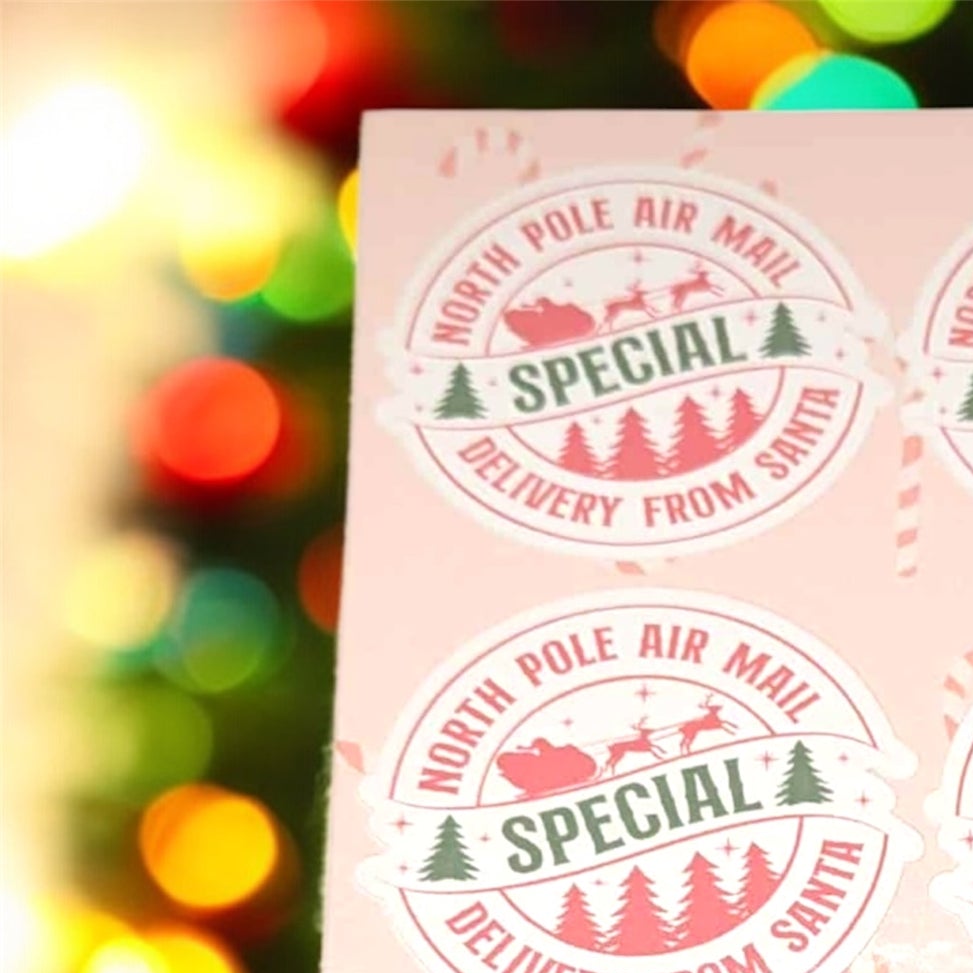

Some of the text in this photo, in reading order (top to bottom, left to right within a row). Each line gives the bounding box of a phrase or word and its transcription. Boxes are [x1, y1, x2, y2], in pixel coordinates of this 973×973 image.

[432, 196, 802, 347] NORTH POLE AIR MAIL
[508, 316, 748, 414] SPECIAL
[457, 385, 840, 528] DELIVERY FROM SANTA
[418, 624, 821, 796] NORTH POLE AIR MAIL
[501, 758, 762, 874] SPECIAL
[770, 839, 864, 953] SANTA
